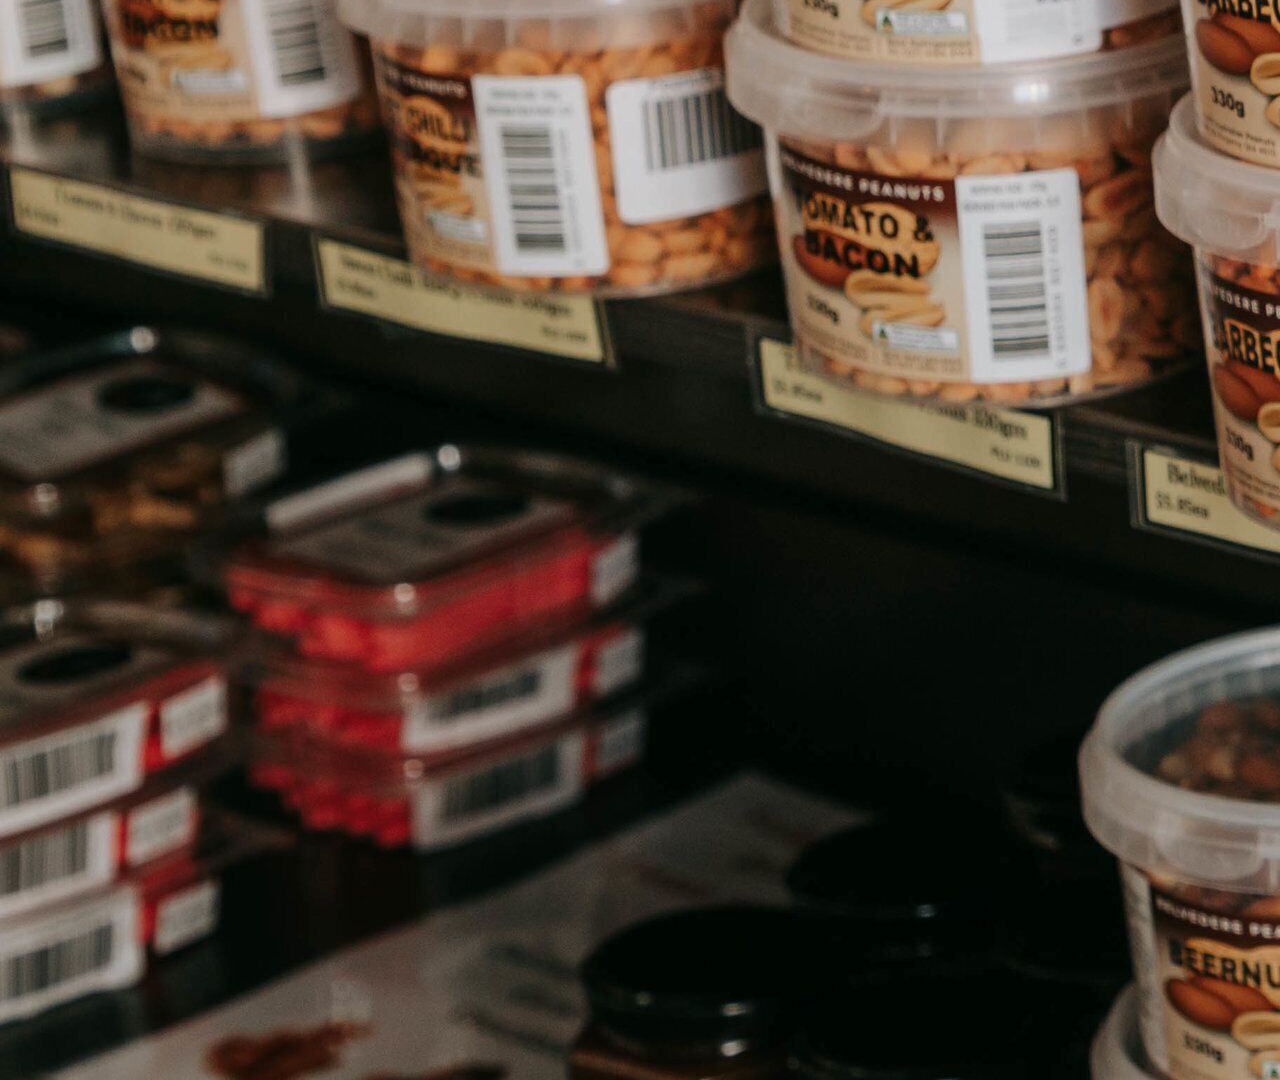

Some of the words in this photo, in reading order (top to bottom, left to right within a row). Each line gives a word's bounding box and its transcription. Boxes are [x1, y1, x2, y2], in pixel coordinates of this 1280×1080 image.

[1210, 86, 1245, 117] 330g
[859, 178, 944, 202] PEANUTS
[914, 216, 934, 242] &
[805, 228, 920, 278] BACON
